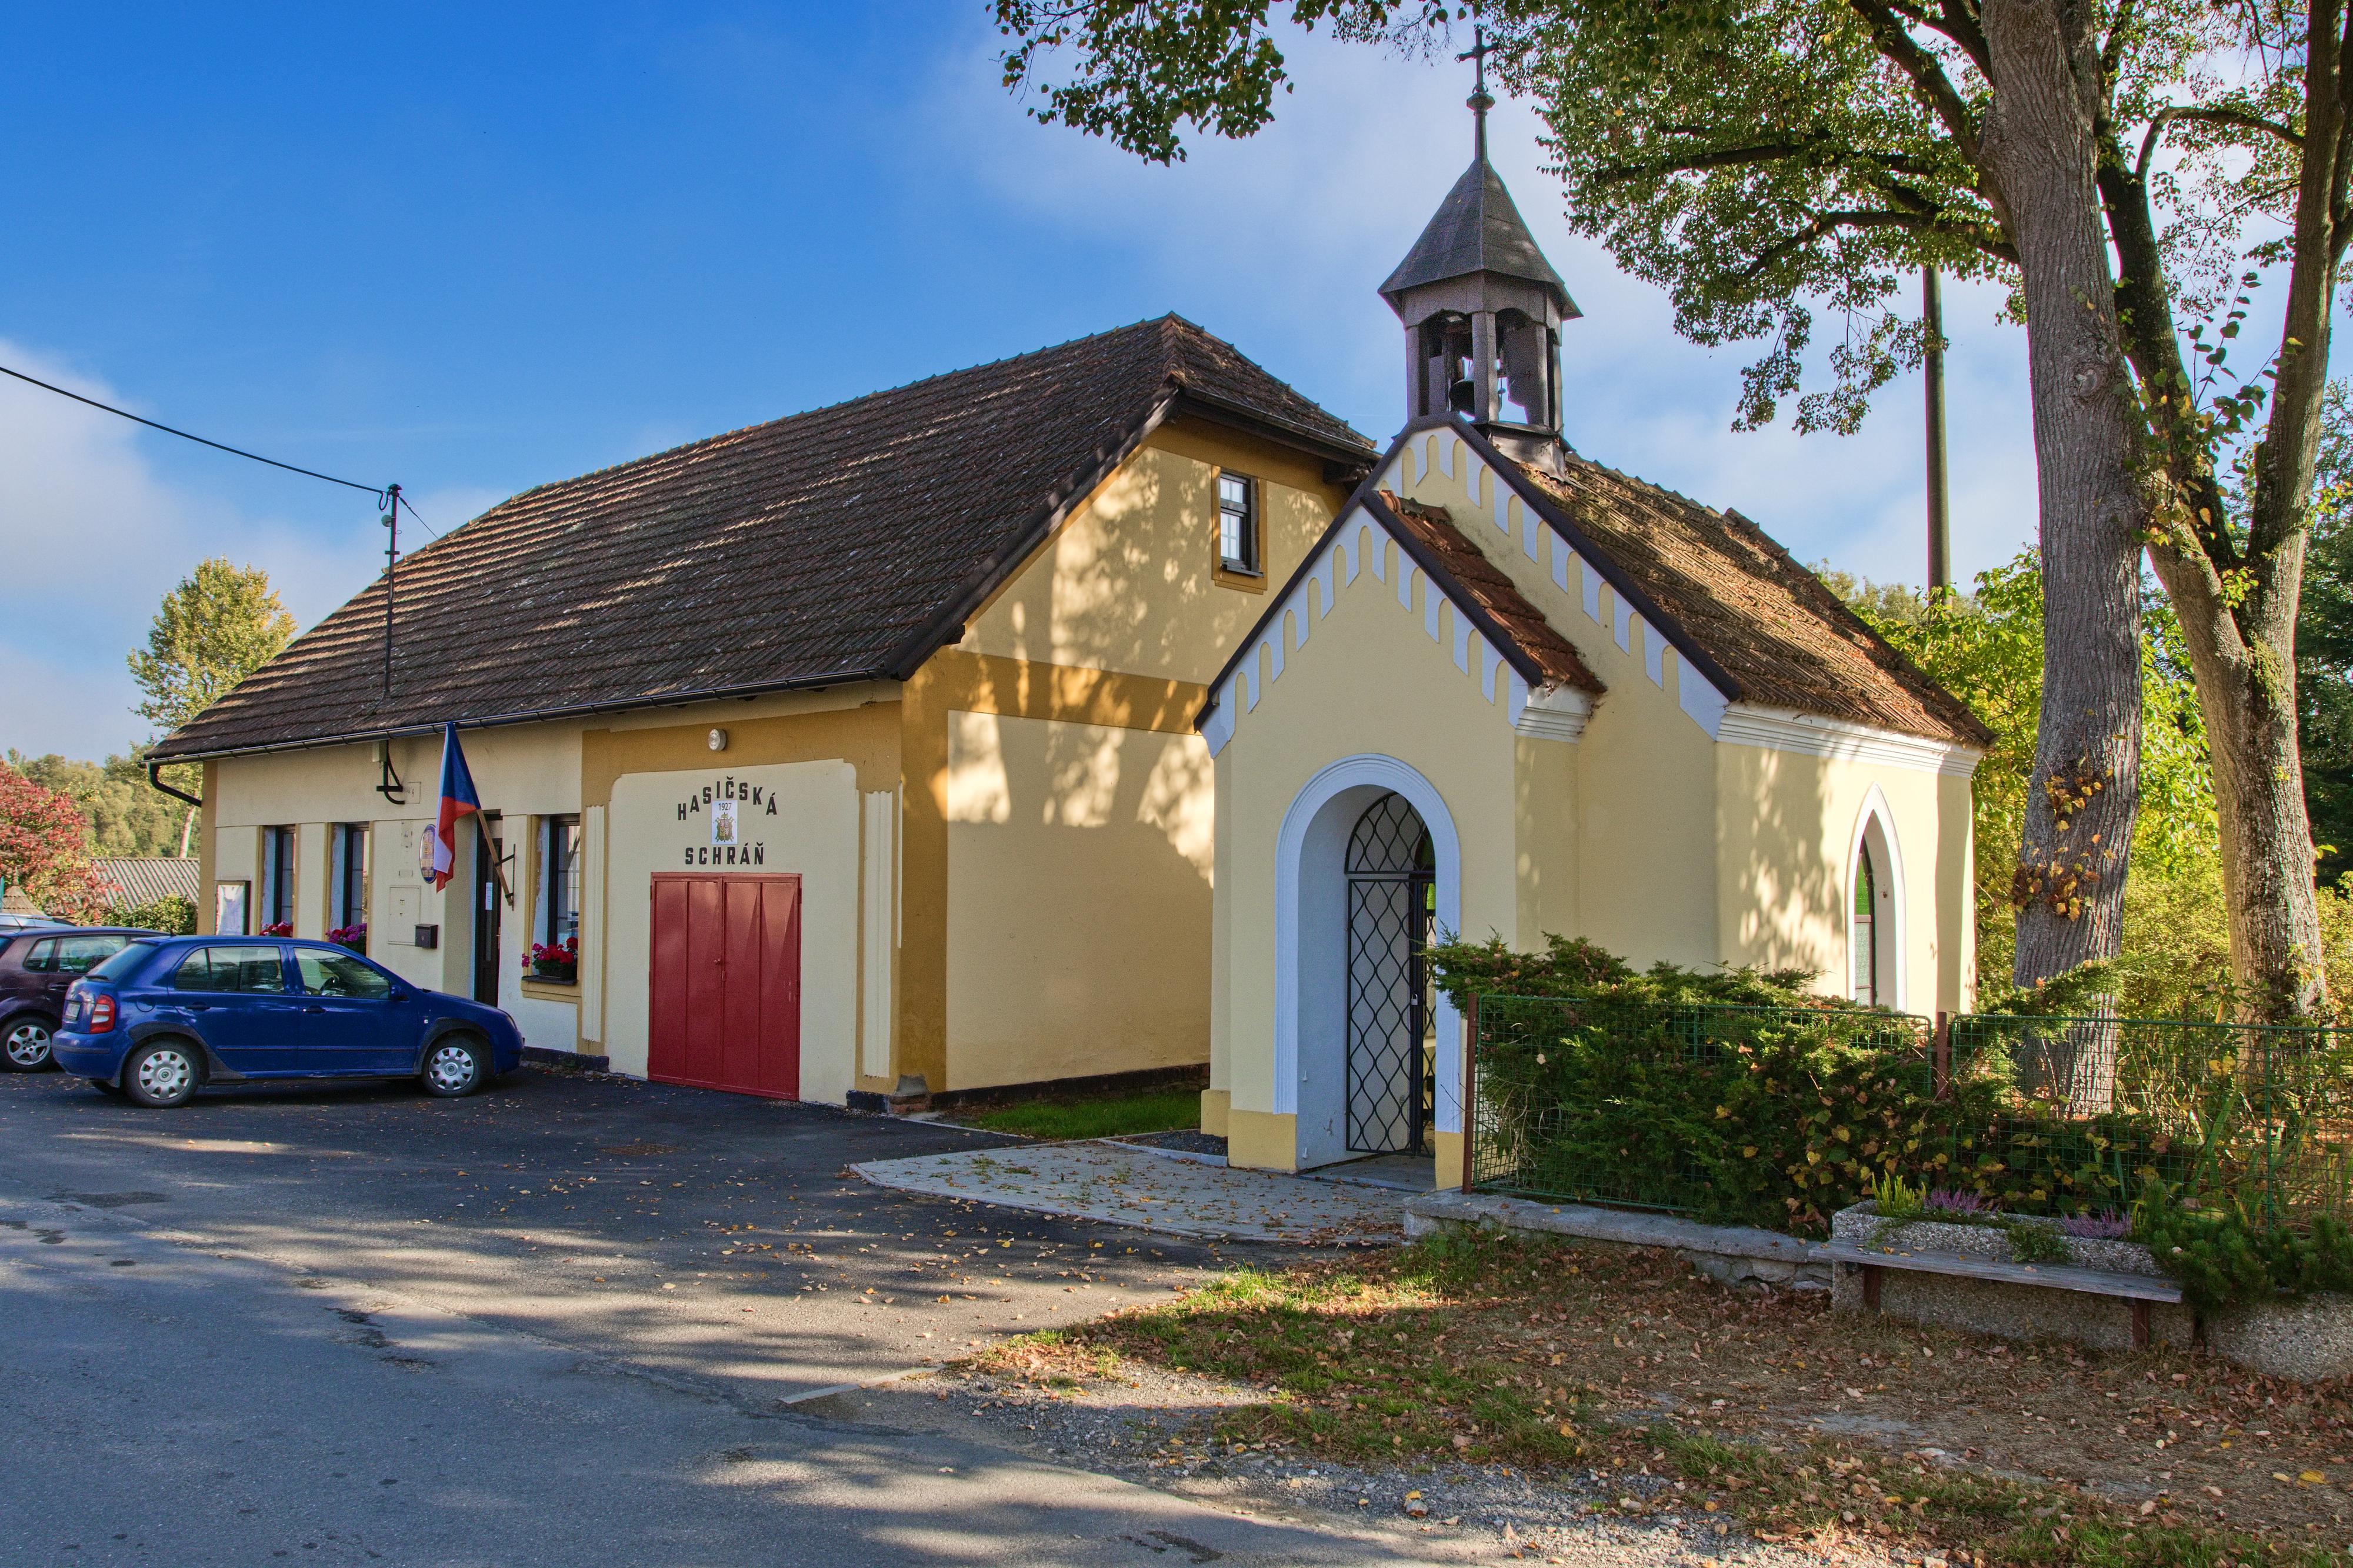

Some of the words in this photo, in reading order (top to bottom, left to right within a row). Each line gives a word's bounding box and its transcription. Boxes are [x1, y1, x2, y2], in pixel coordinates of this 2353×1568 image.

[678, 776, 777, 820] HASIČSKÁ
[718, 802, 732, 811] 1927
[685, 842, 764, 865] SCHRÁŇ
